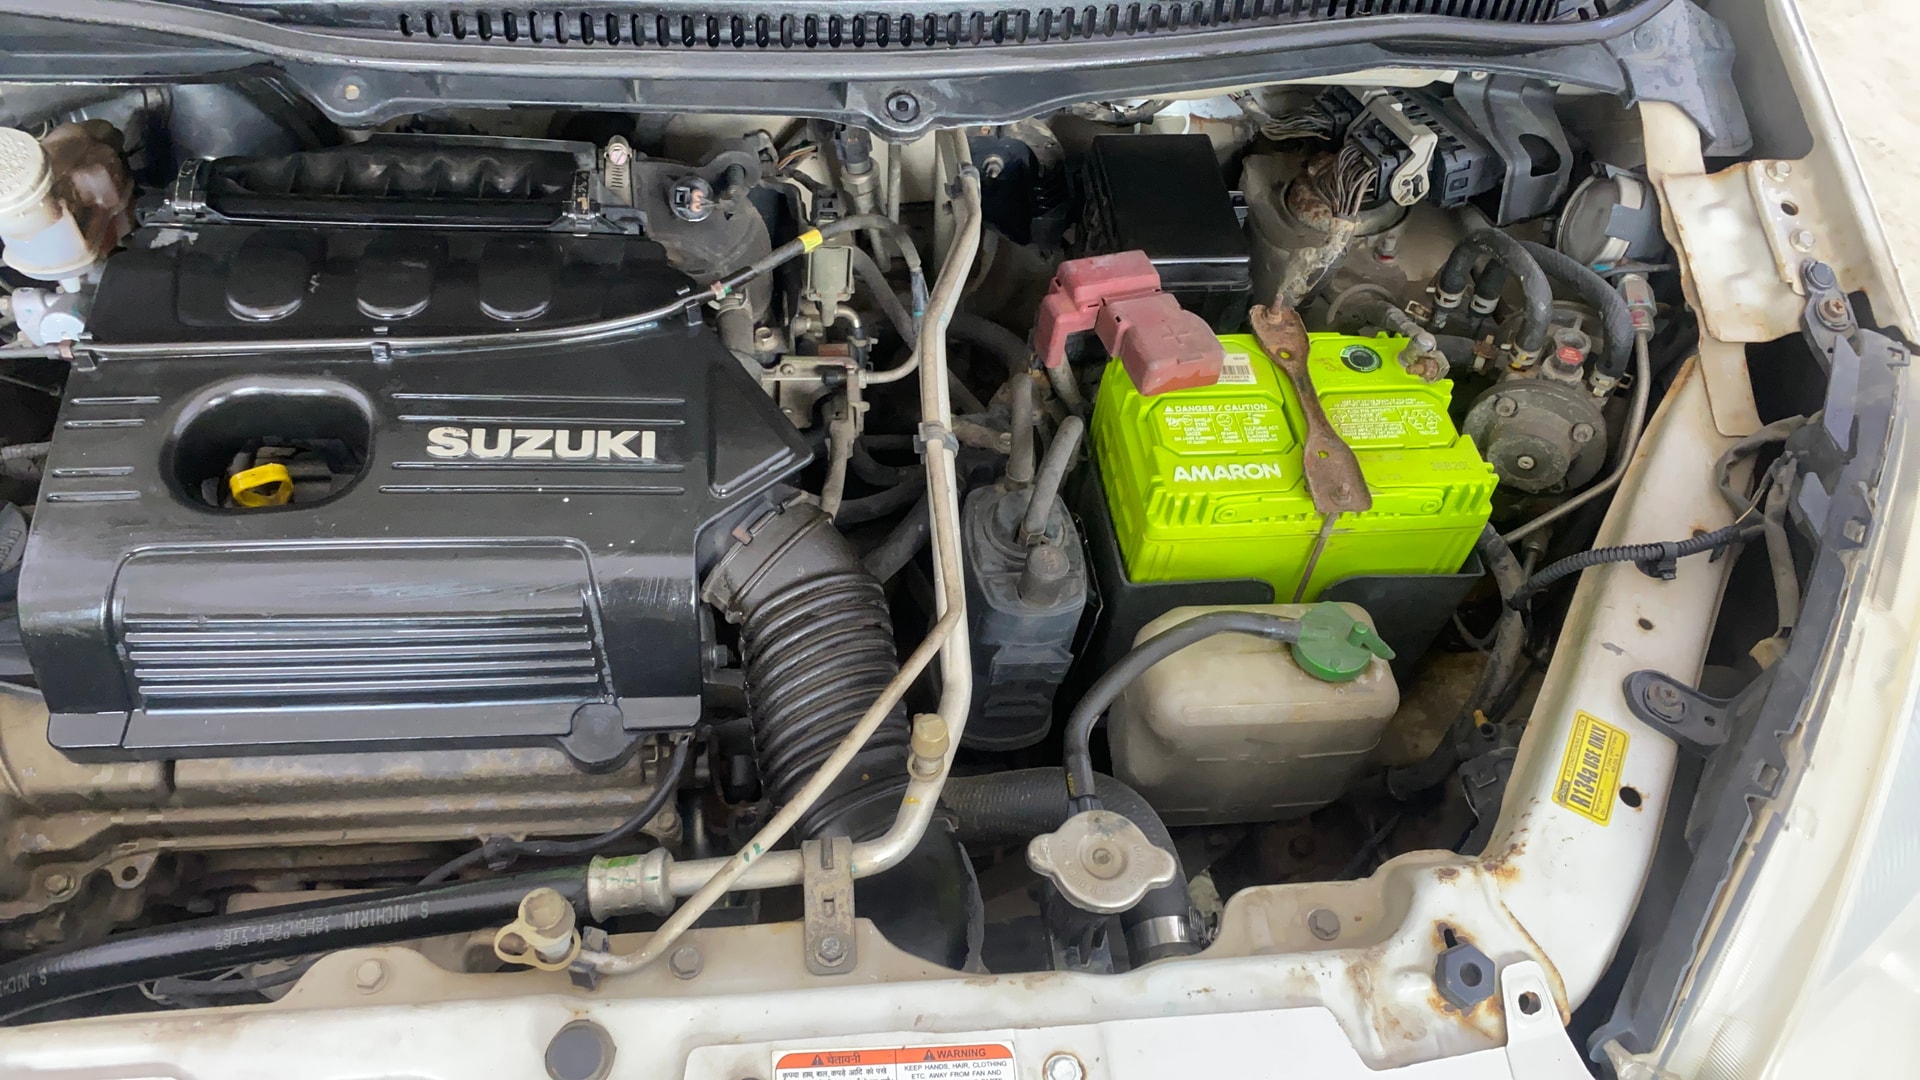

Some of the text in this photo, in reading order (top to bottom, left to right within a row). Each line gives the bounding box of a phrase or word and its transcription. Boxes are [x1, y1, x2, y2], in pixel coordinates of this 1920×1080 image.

[1224, 403, 1268, 411] CAUTION
[426, 426, 656, 461] SUZUKI
[1173, 463, 1282, 482] AMARON
[1570, 723, 1607, 809] R134a USE ONLY
[345, 904, 409, 930] NICHIRIN
[827, 1052, 861, 1065] चेतावनी
[937, 1048, 986, 1059] WARNING
